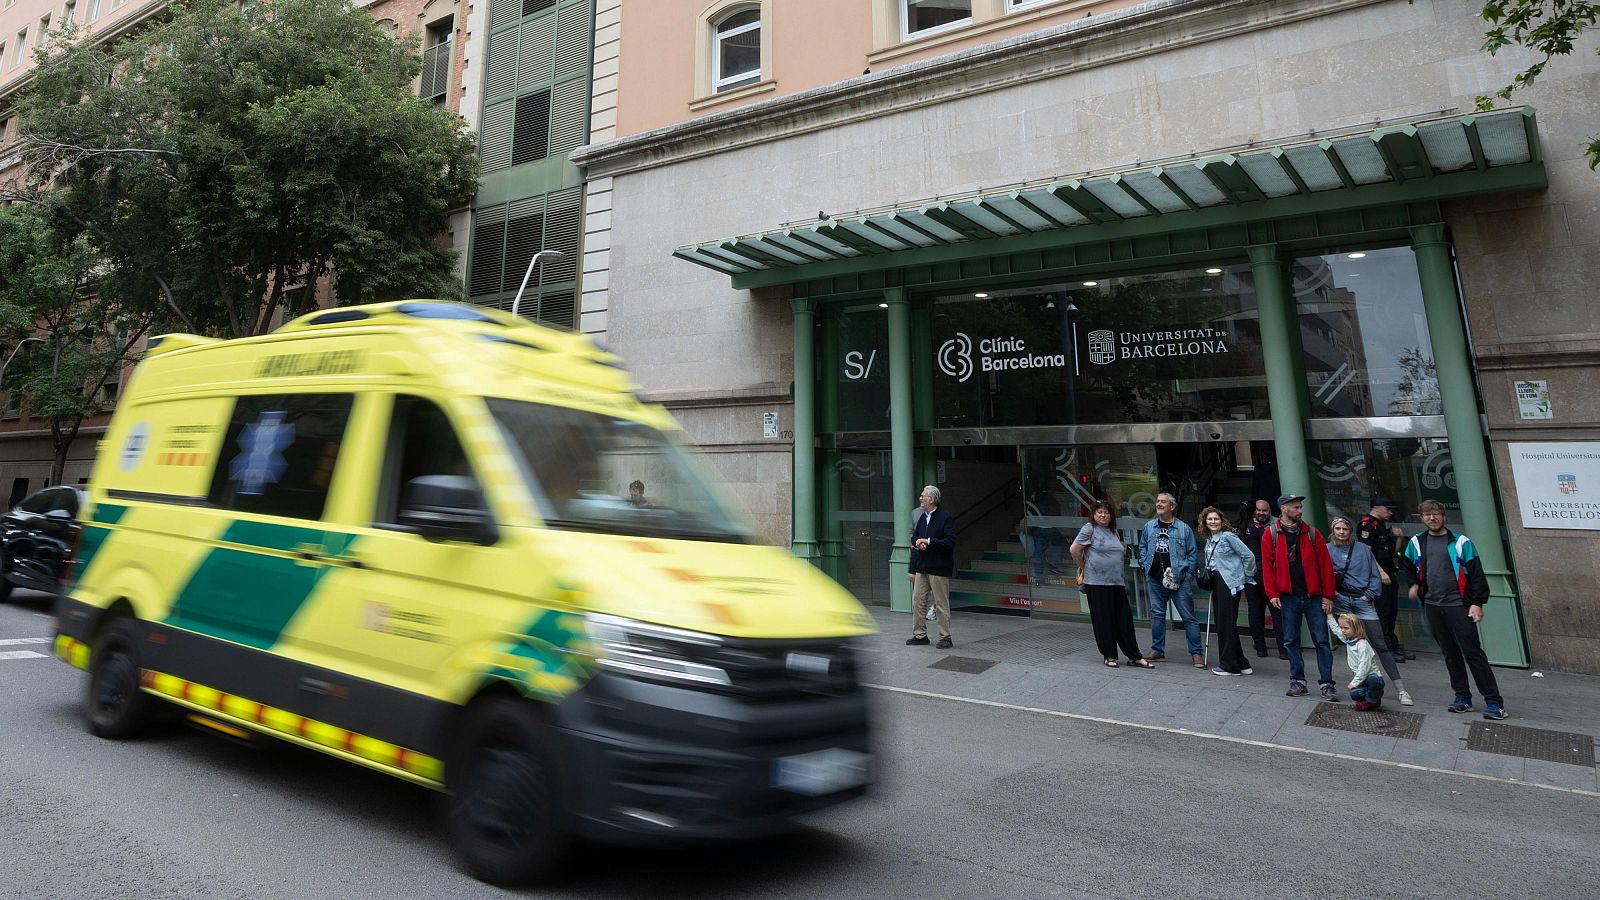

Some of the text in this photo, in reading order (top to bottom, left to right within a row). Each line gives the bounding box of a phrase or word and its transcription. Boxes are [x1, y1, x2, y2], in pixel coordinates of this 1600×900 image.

[1120, 328, 1213, 345] UNIVERSITAT
[980, 336, 1026, 355] Clínic
[1121, 340, 1228, 359] BARCELONA
[982, 354, 1066, 372] Barcelona
[781, 431, 793, 439] 170
[1521, 452, 1555, 460] Hospital
